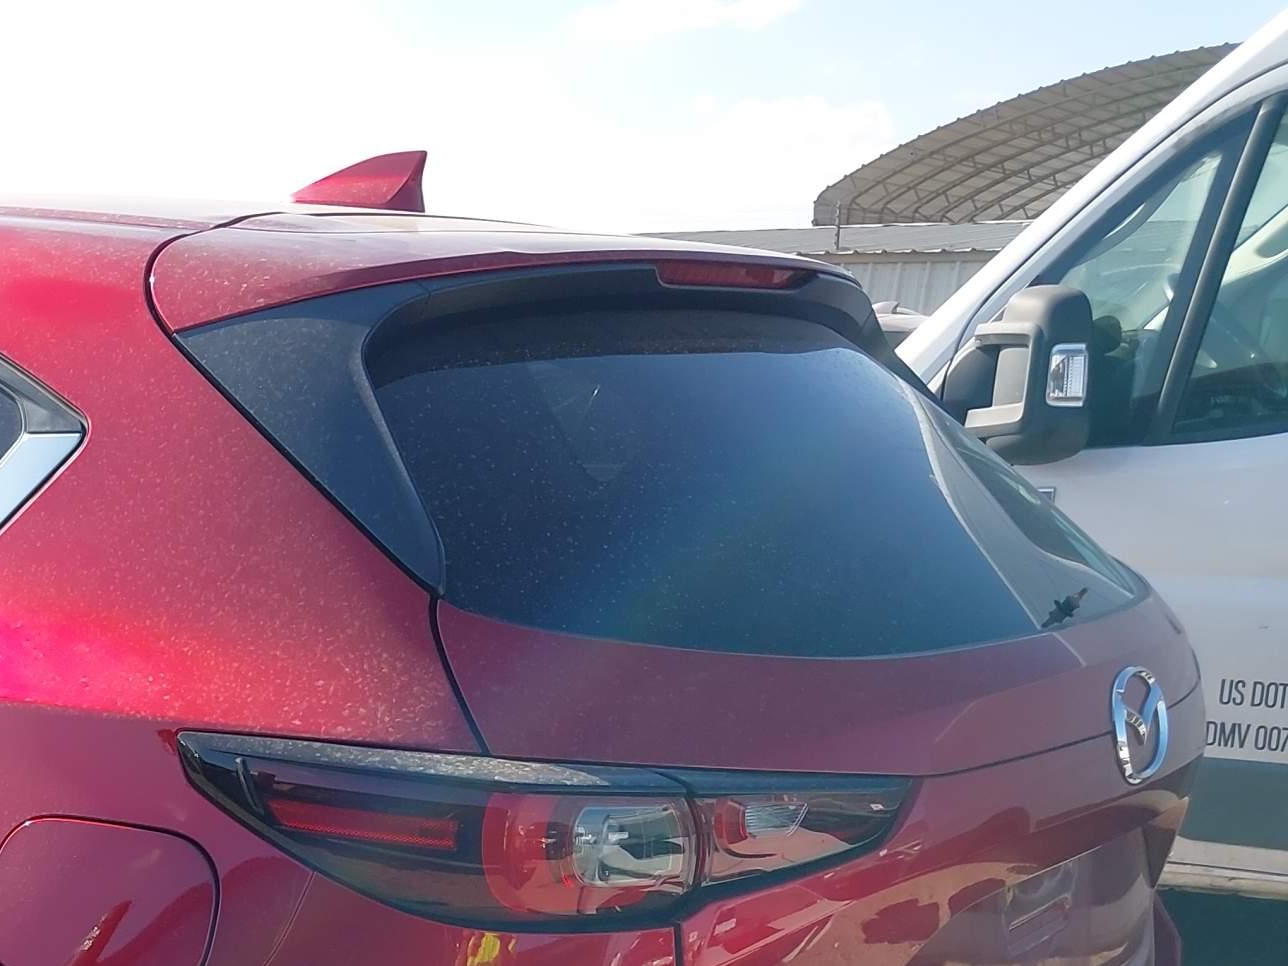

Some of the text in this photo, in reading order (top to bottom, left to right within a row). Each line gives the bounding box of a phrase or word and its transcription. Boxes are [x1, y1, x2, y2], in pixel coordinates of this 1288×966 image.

[1219, 679, 1288, 709] US DOT
[1206, 721, 1252, 749] DMV
